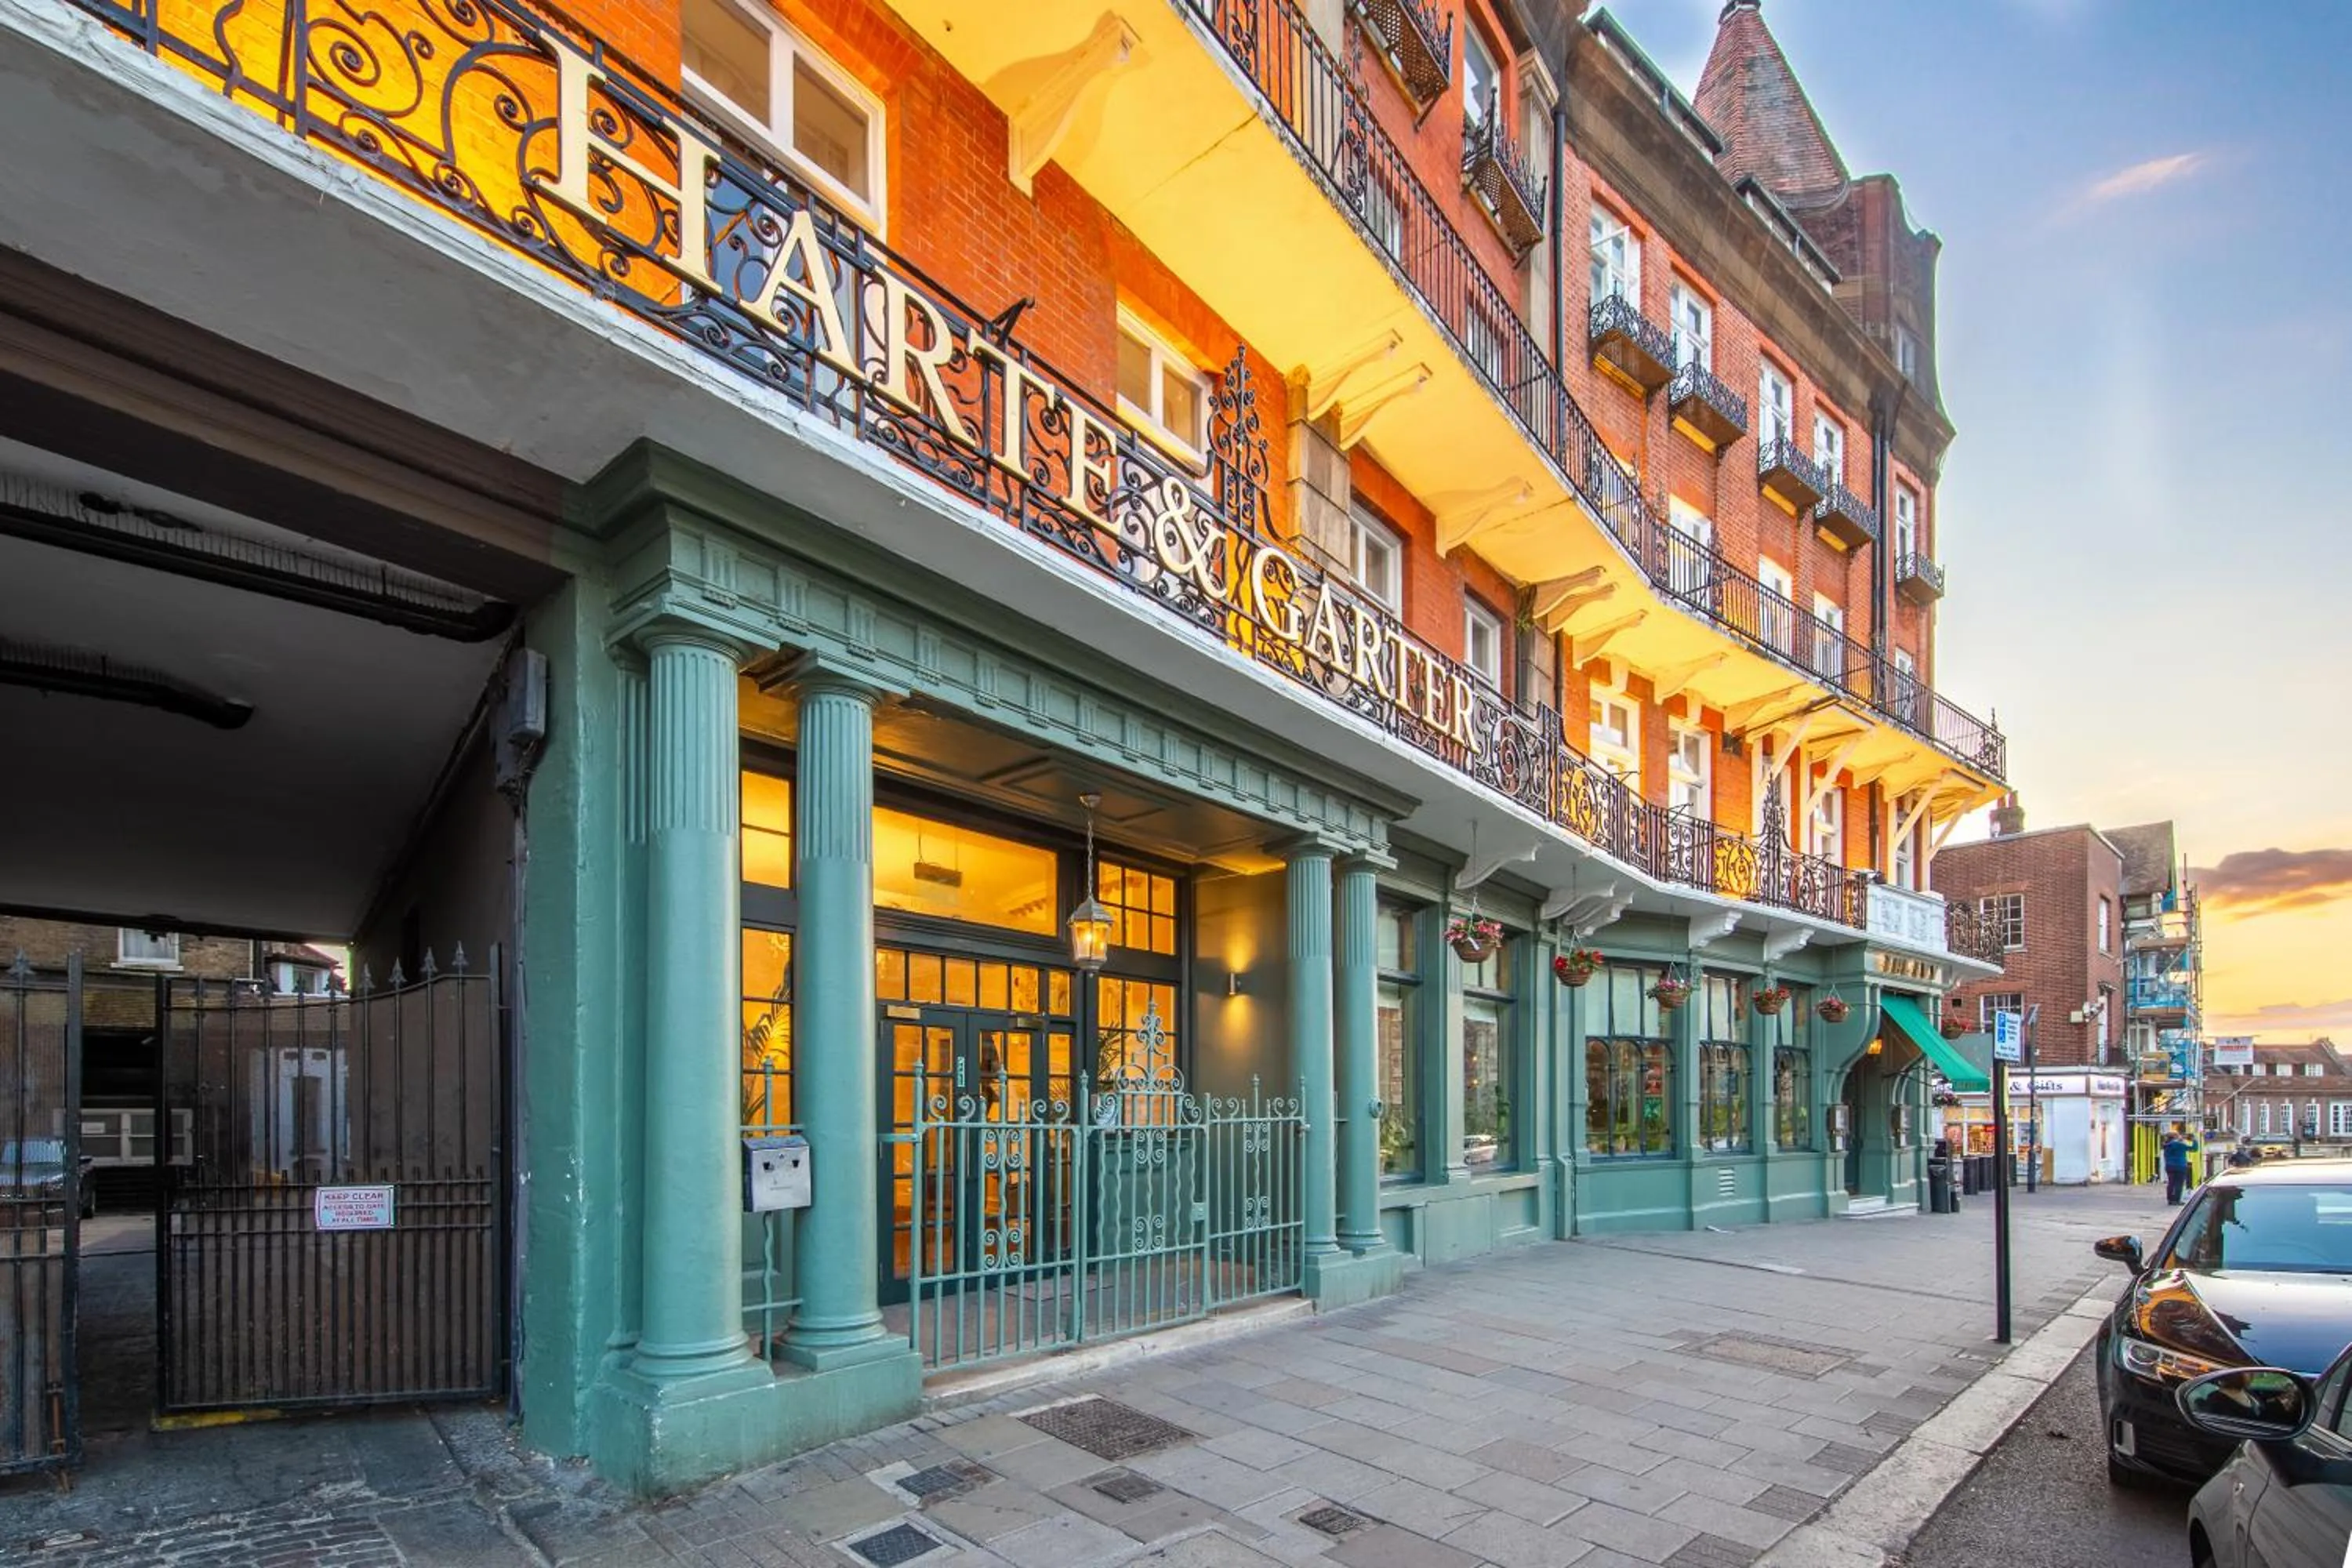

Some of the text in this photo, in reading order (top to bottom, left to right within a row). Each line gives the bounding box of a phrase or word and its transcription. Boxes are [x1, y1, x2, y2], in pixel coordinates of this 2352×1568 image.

[535, 30, 1481, 755] HARTE & GARTER
[2009, 1081, 2021, 1091] &
